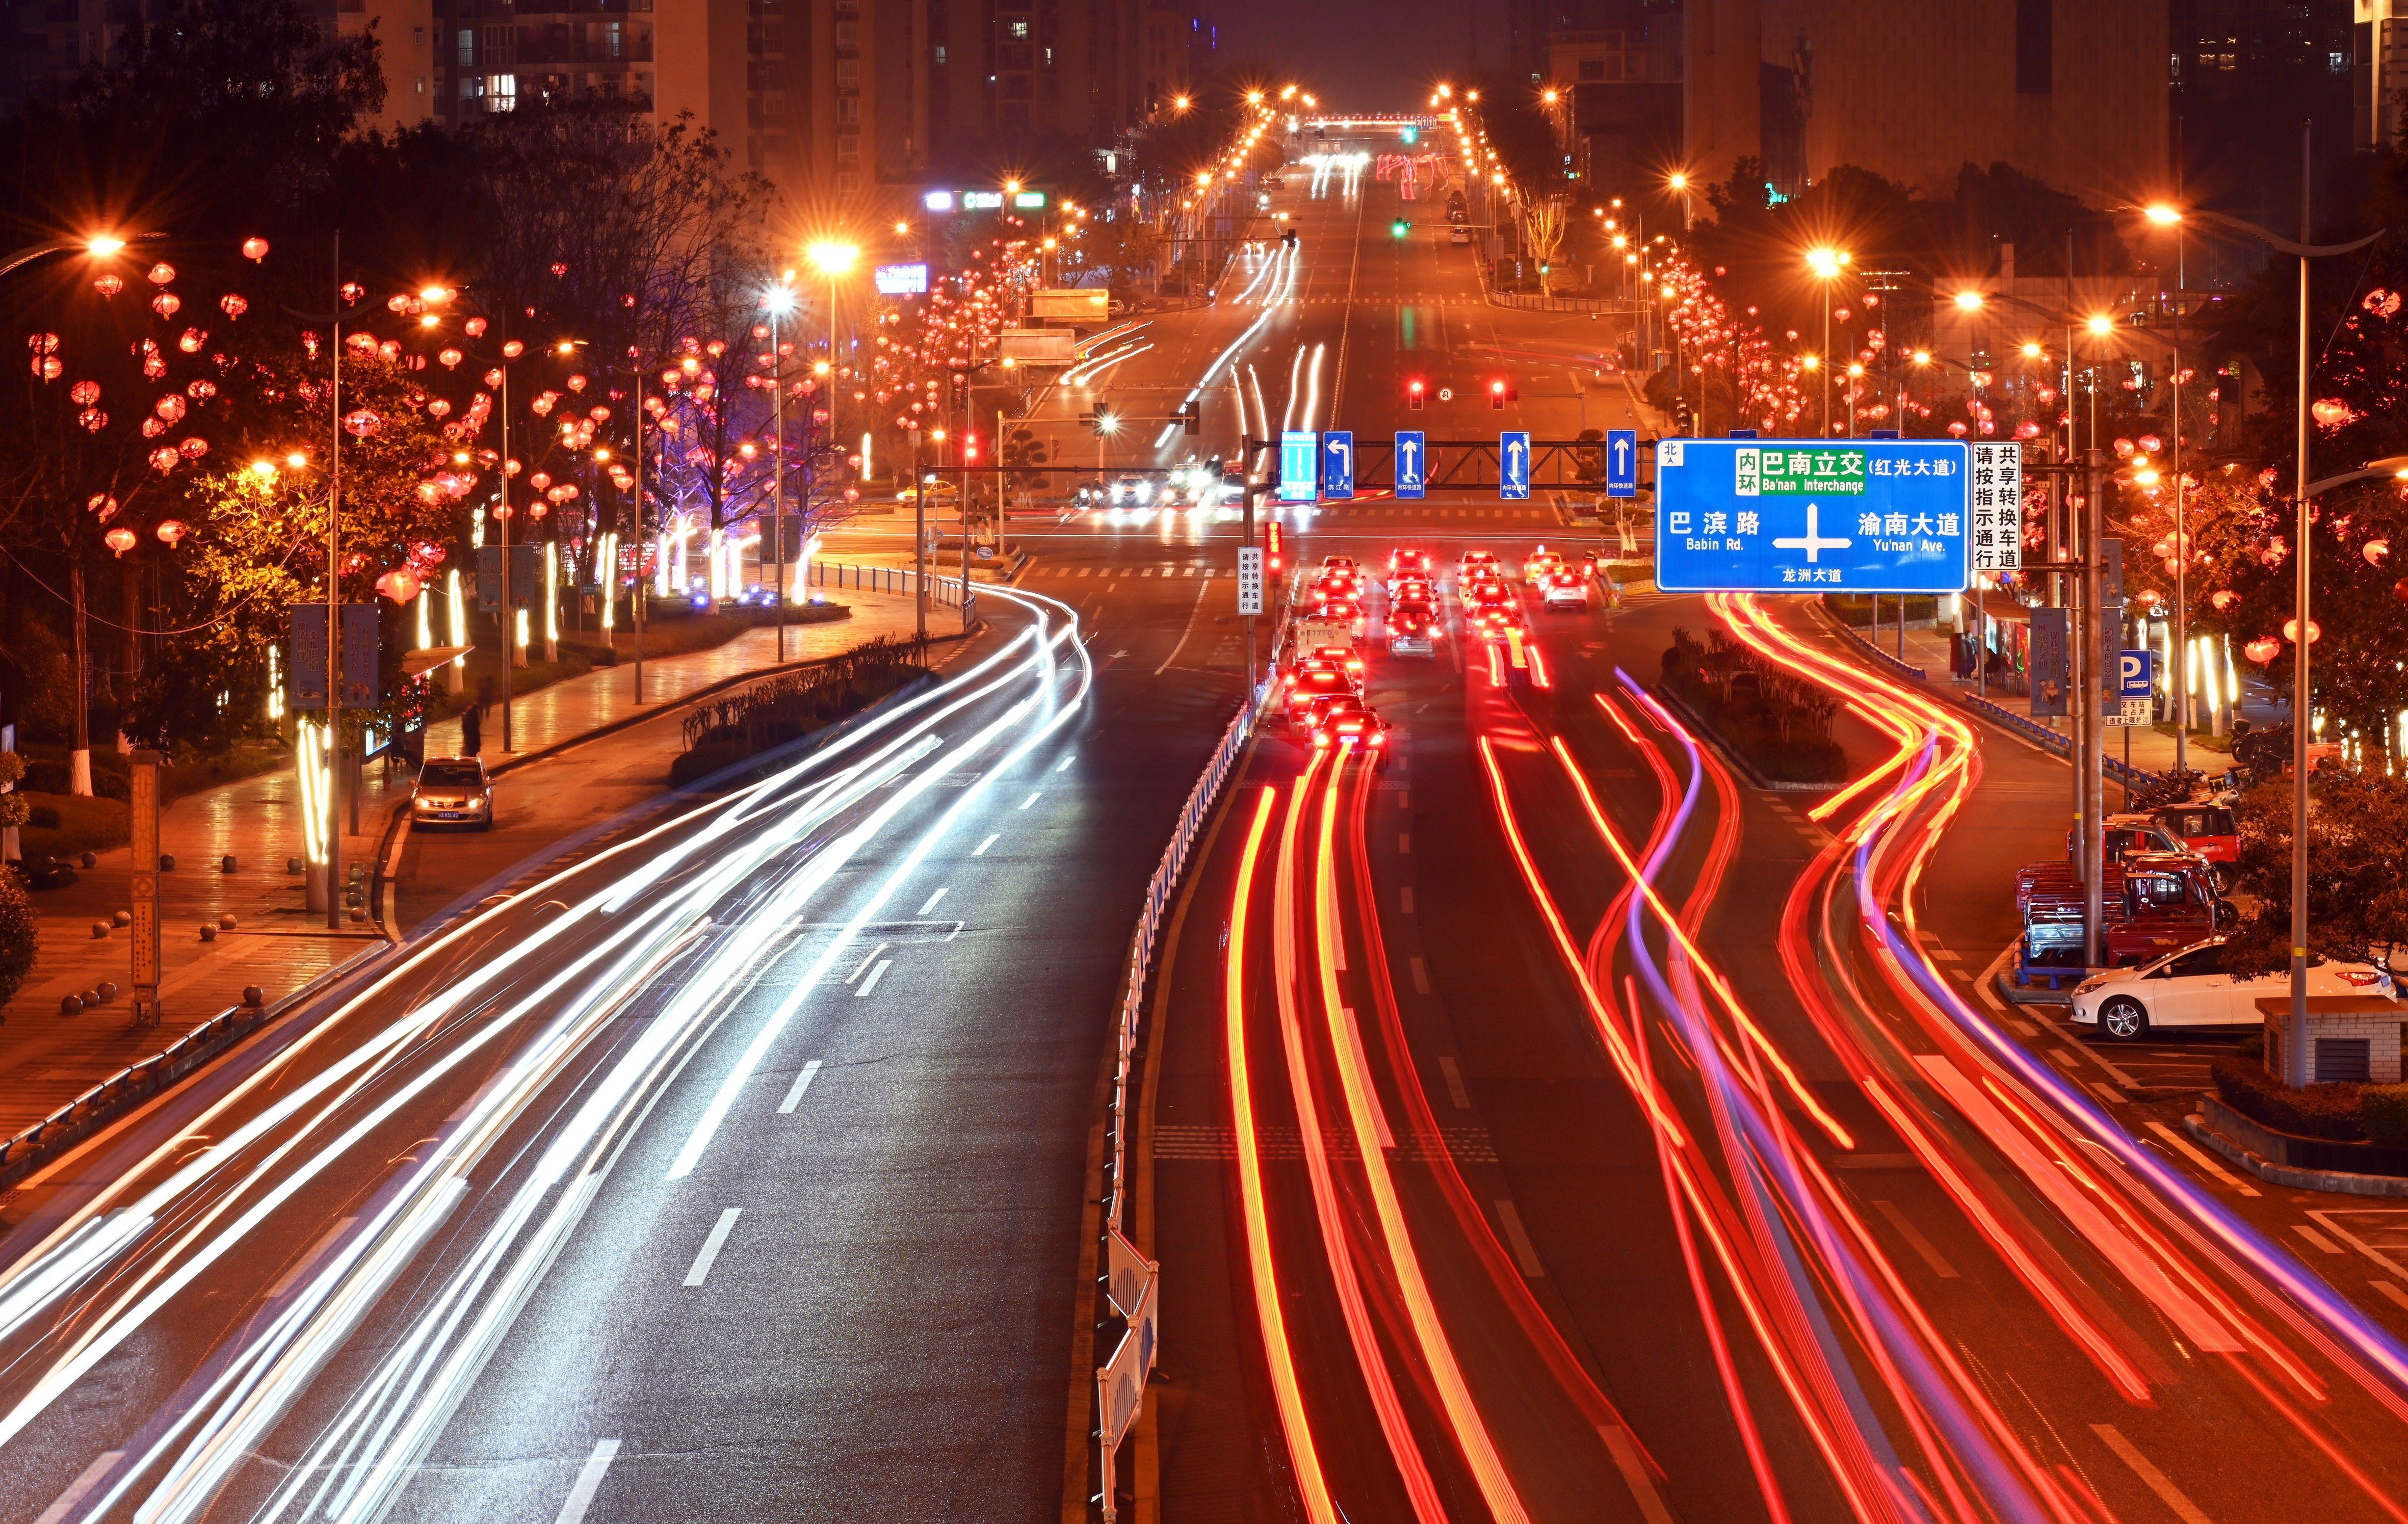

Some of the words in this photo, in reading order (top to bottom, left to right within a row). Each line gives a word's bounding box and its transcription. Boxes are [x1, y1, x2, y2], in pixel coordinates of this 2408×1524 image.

[1664, 443, 1677, 455] 北
[1739, 453, 1756, 492] 内环
[1763, 452, 1863, 476] 巴南立交
[1869, 459, 1956, 476] (红光大道)
[1763, 479, 1796, 490] Ba'nan
[1804, 479, 1863, 494] Interchange
[1976, 447, 1993, 567] 请按指示通行
[1999, 446, 2017, 567] 共享转换车道
[1670, 511, 1760, 535] 巴滨路
[1859, 512, 1959, 536] 渝南大道
[1687, 538, 1719, 549] Babin
[1726, 538, 1743, 550] Rd.
[1873, 539, 1913, 551] Yu'nan
[1921, 539, 1945, 551] Ave.
[1783, 568, 1842, 582] 龙洲大道
[2121, 656, 2141, 690] P
[6, 731, 10, 752] P
